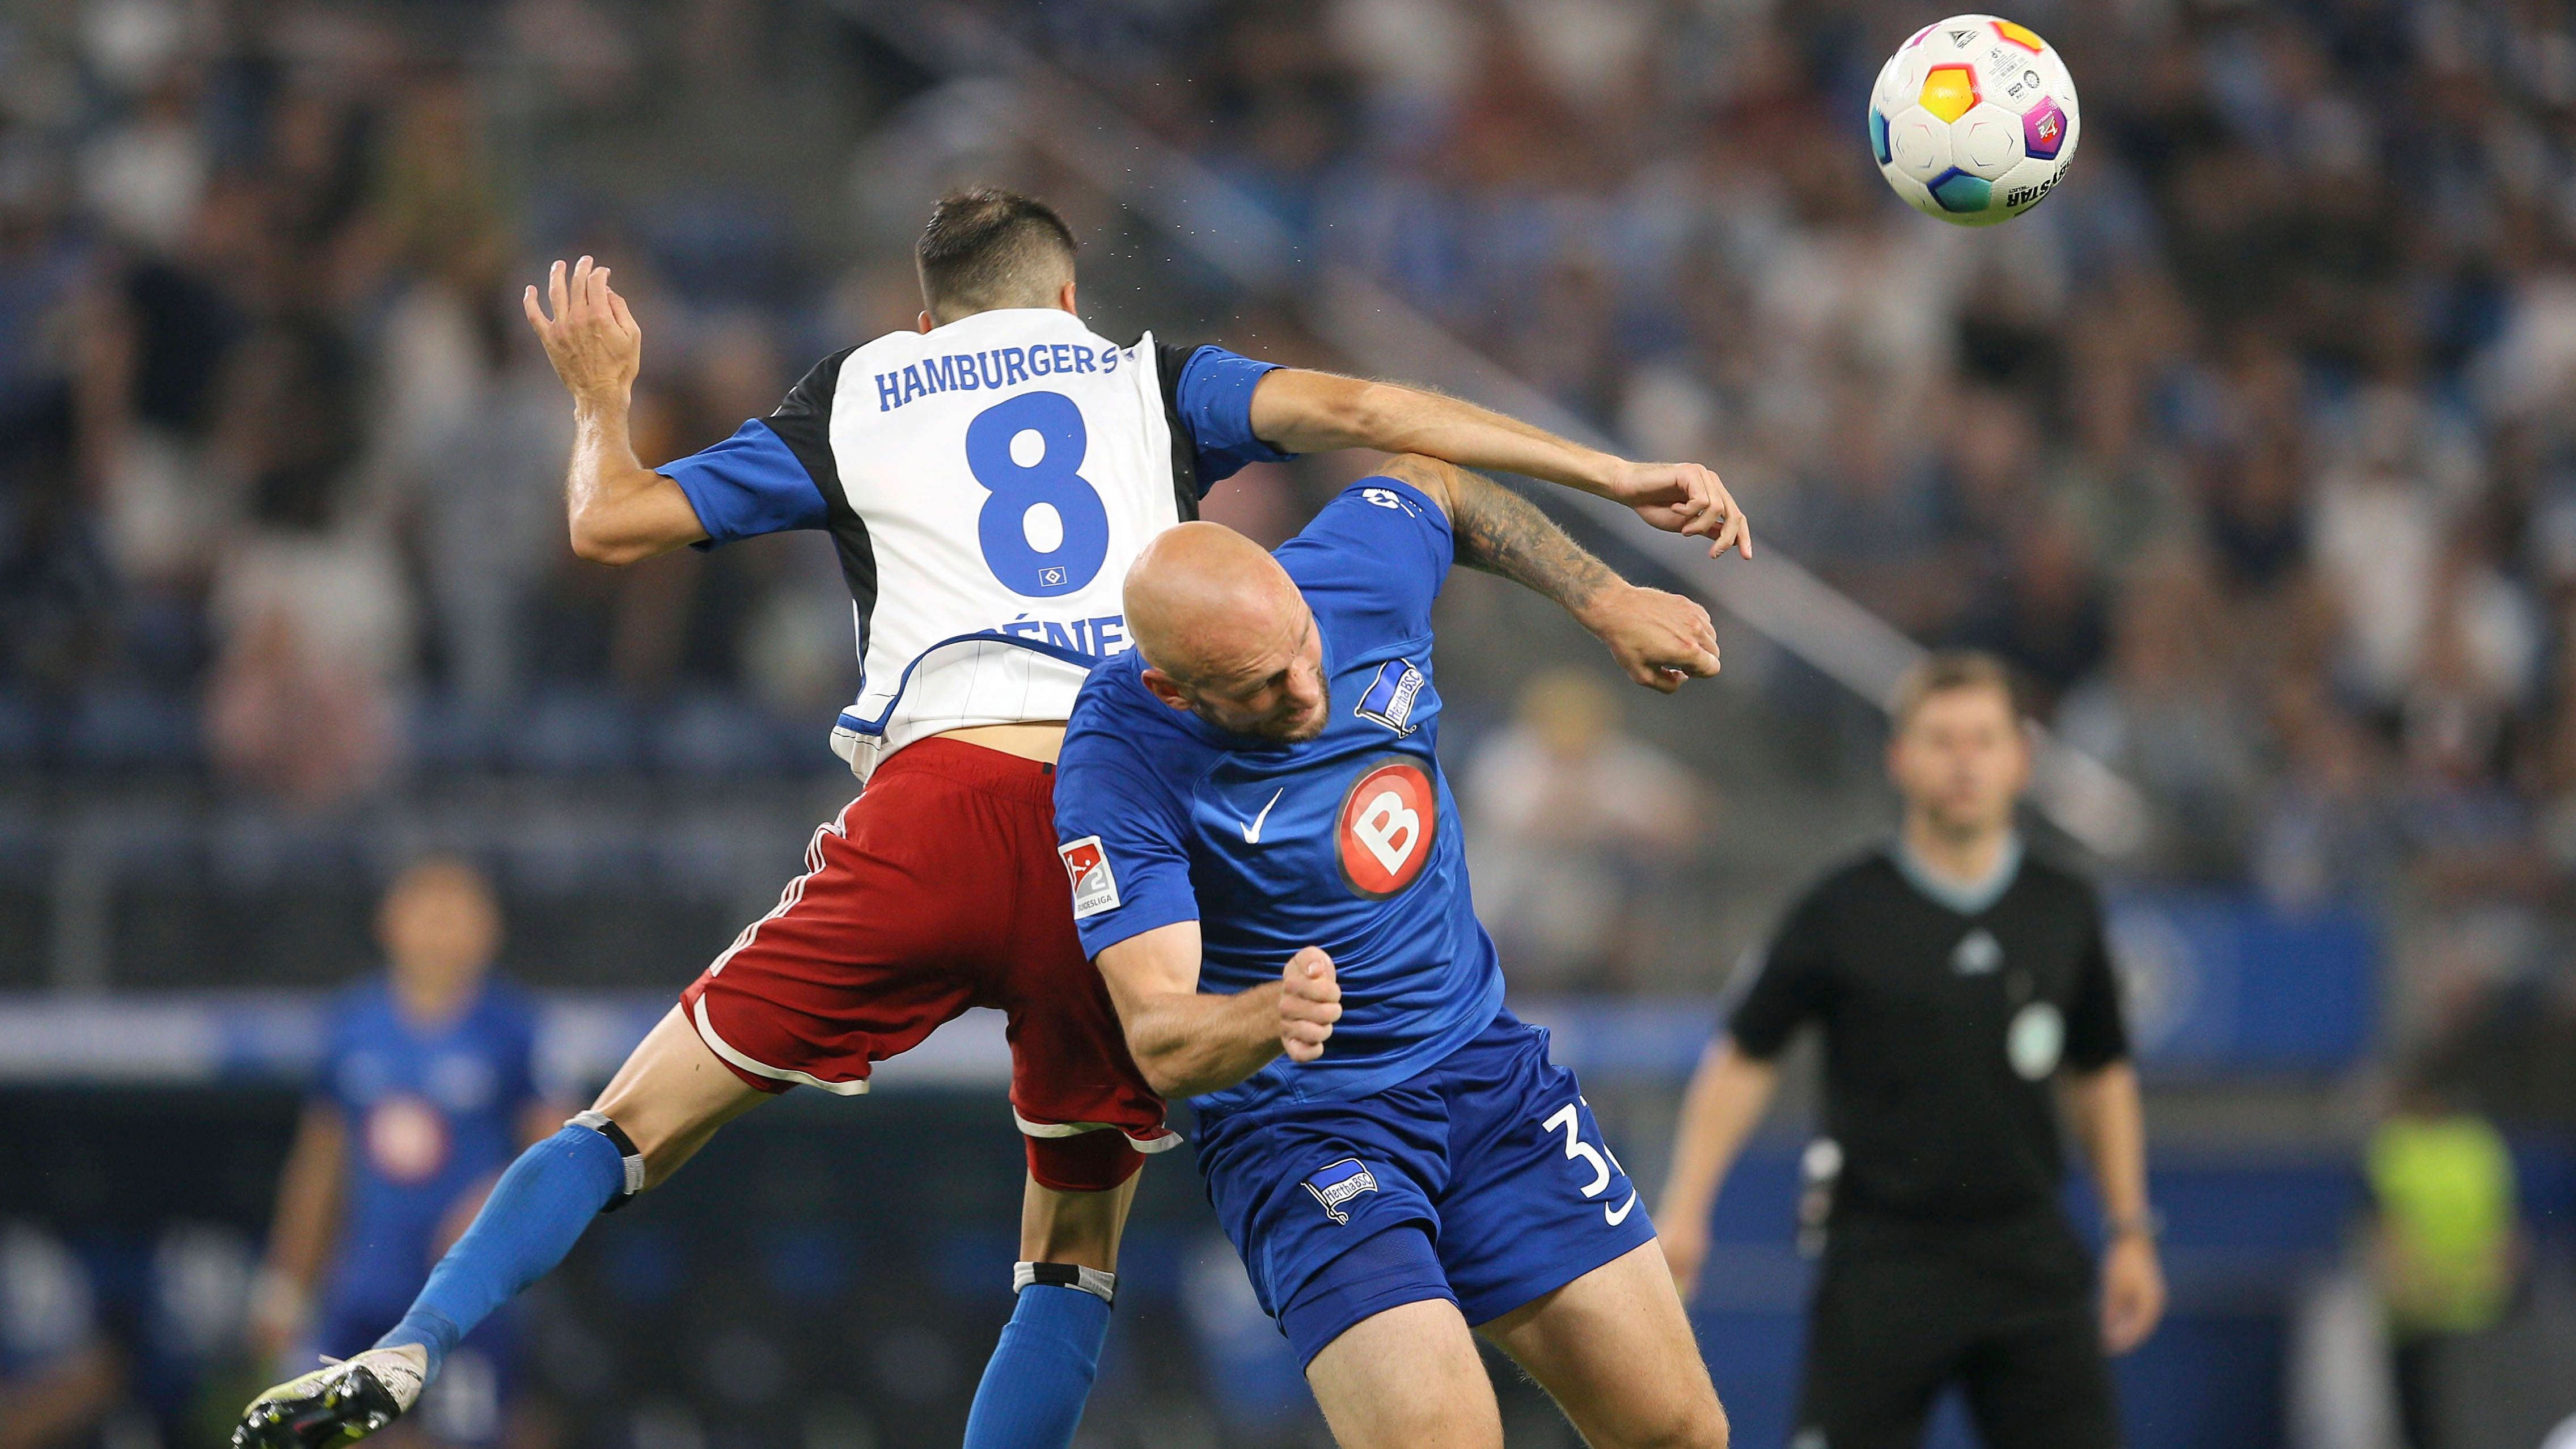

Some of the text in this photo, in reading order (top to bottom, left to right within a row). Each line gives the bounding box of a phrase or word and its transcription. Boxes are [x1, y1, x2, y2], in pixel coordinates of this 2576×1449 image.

[875, 344, 1095, 412] HAMBURGER
[965, 390, 1109, 598] 8
[1353, 791, 1420, 876] B
[1090, 868, 1106, 890] 2
[1542, 1095, 1626, 1198] 3
